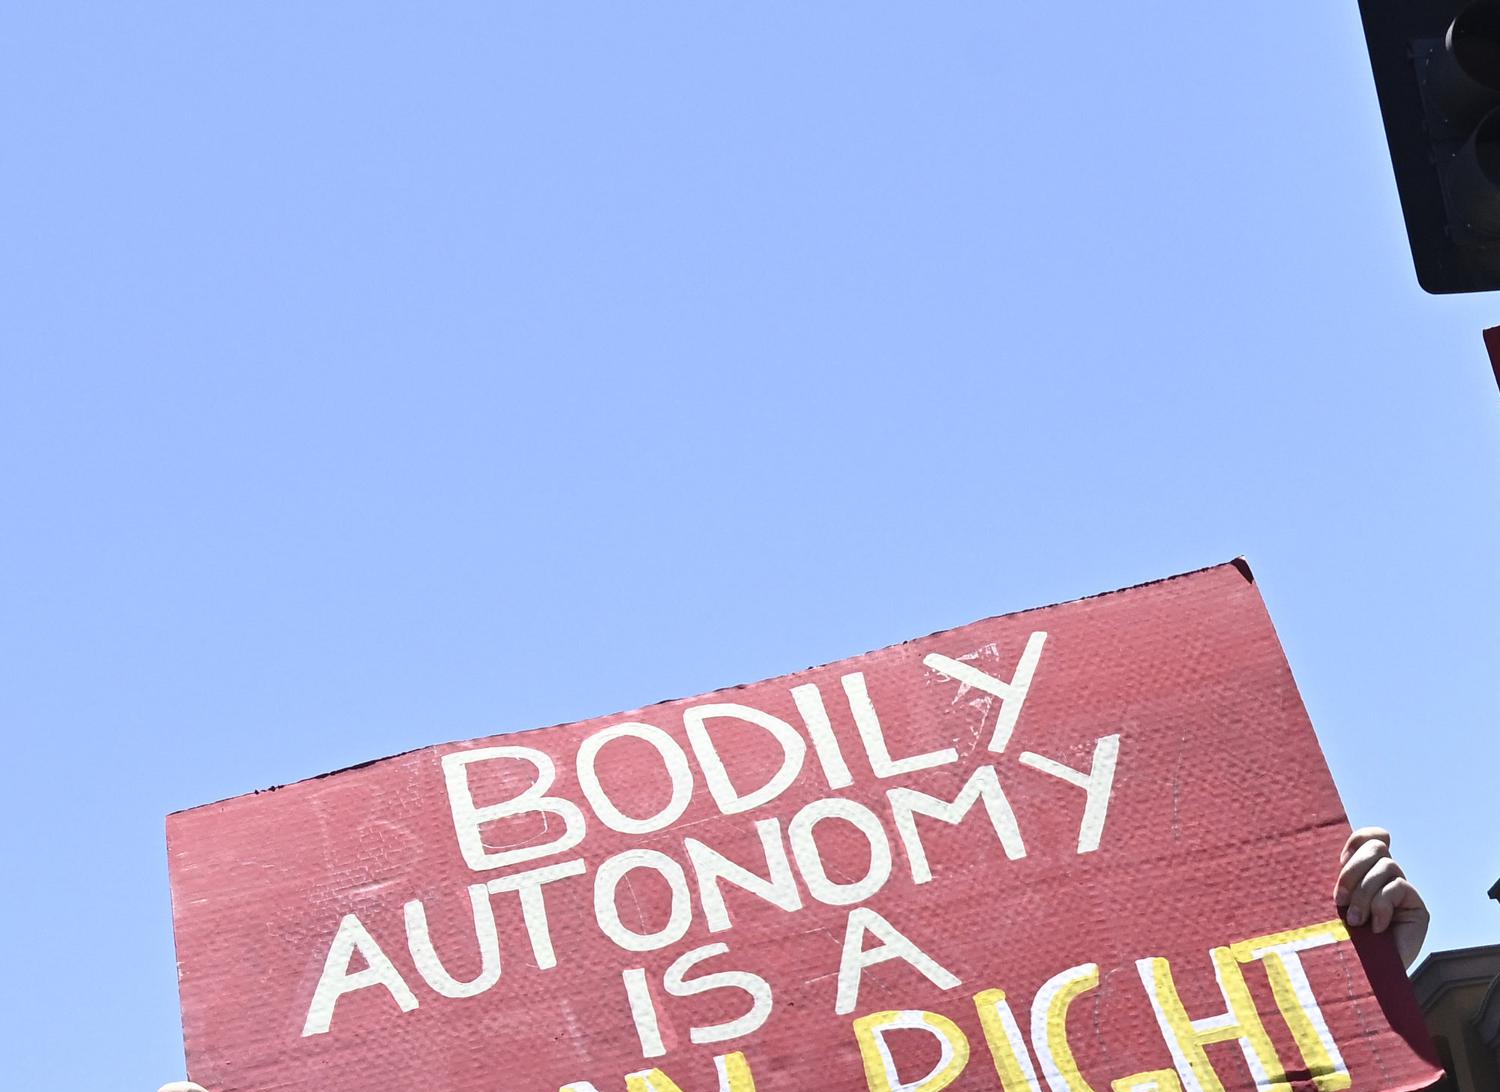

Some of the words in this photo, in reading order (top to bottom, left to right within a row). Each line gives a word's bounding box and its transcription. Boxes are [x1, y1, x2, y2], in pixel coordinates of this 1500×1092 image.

[441, 631, 1047, 872] BODILY
[300, 733, 1121, 1037] AUTONOMY
[622, 942, 773, 1058] IS
[835, 907, 961, 1014] A
